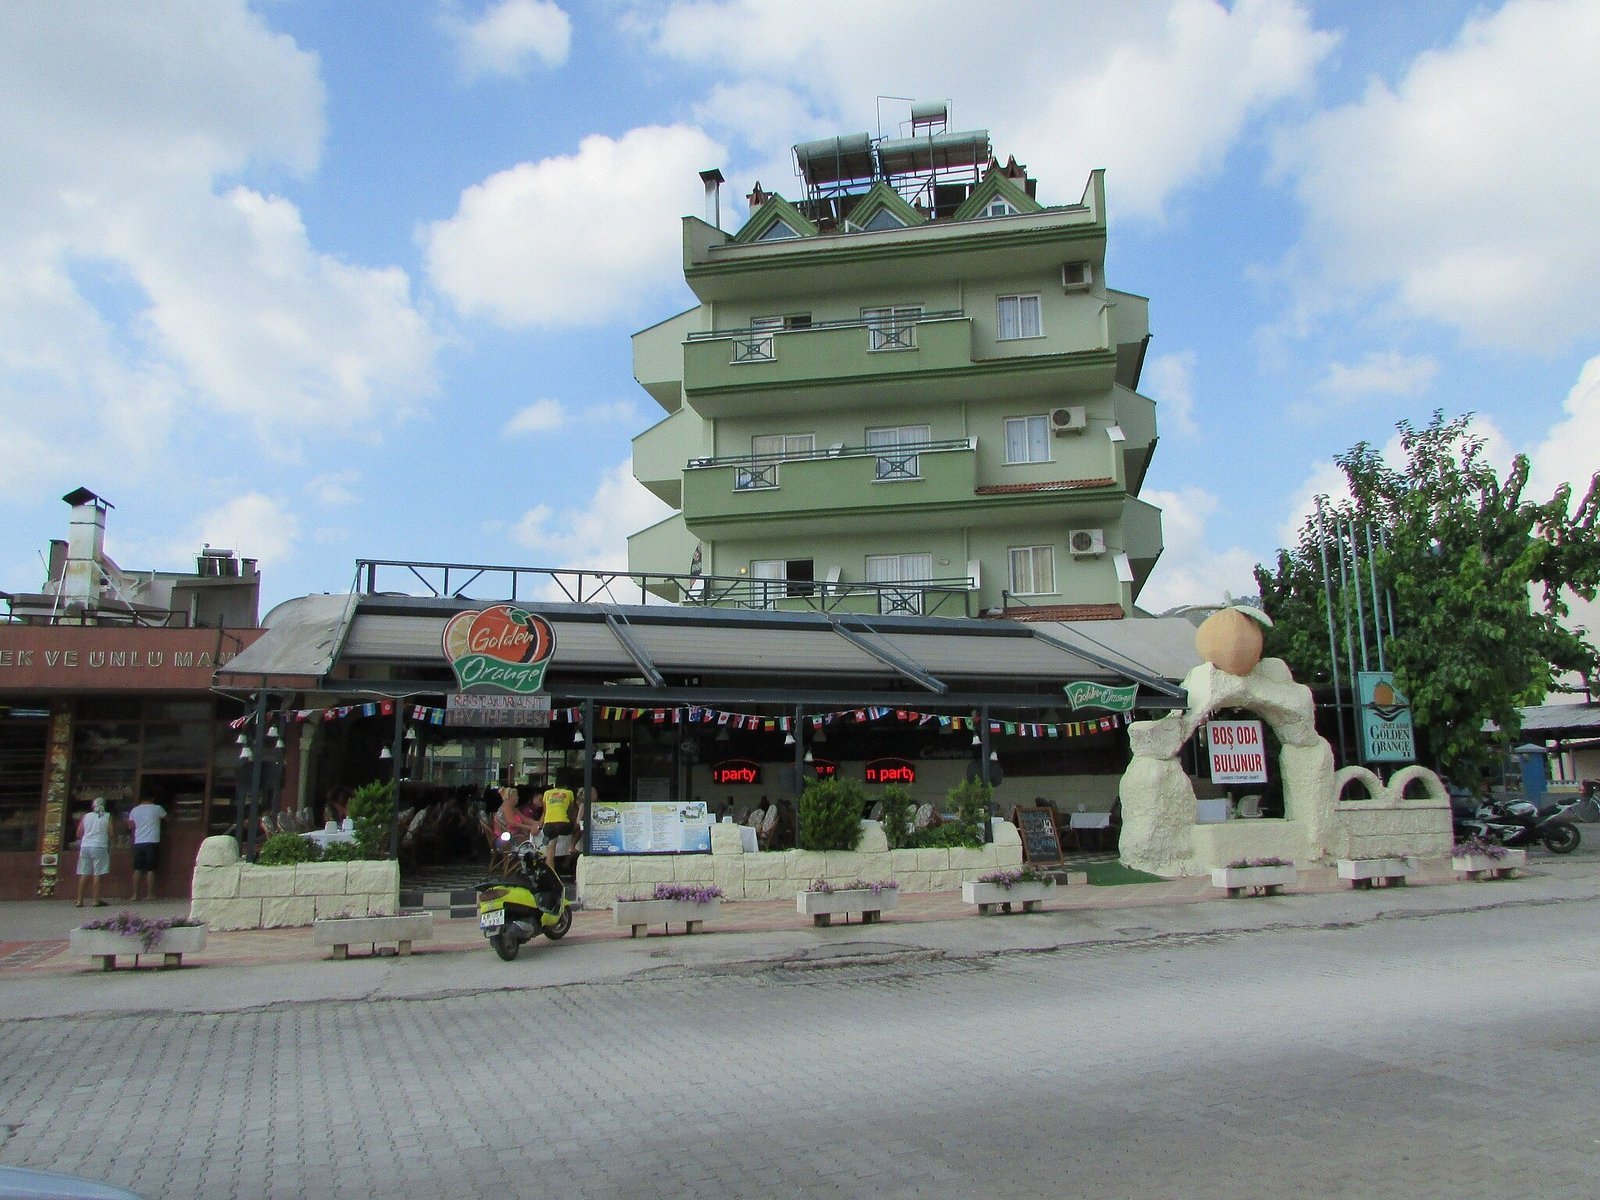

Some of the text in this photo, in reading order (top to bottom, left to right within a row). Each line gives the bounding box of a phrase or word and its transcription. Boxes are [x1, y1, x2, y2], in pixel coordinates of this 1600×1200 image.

[472, 624, 534, 651] Golden
[45, 650, 78, 667] VE
[89, 651, 163, 667] UNLU
[462, 657, 540, 690] Orange
[454, 696, 544, 709] RESTAURANT
[479, 709, 508, 724] THE
[513, 709, 549, 725] BEST
[1212, 726, 1258, 750] BOŞ ODA
[1370, 725, 1410, 740] GOLDEN
[1371, 741, 1410, 757] ORANGE
[1213, 753, 1263, 772] BULUNUR
[721, 767, 756, 783] party
[880, 766, 914, 782] party
